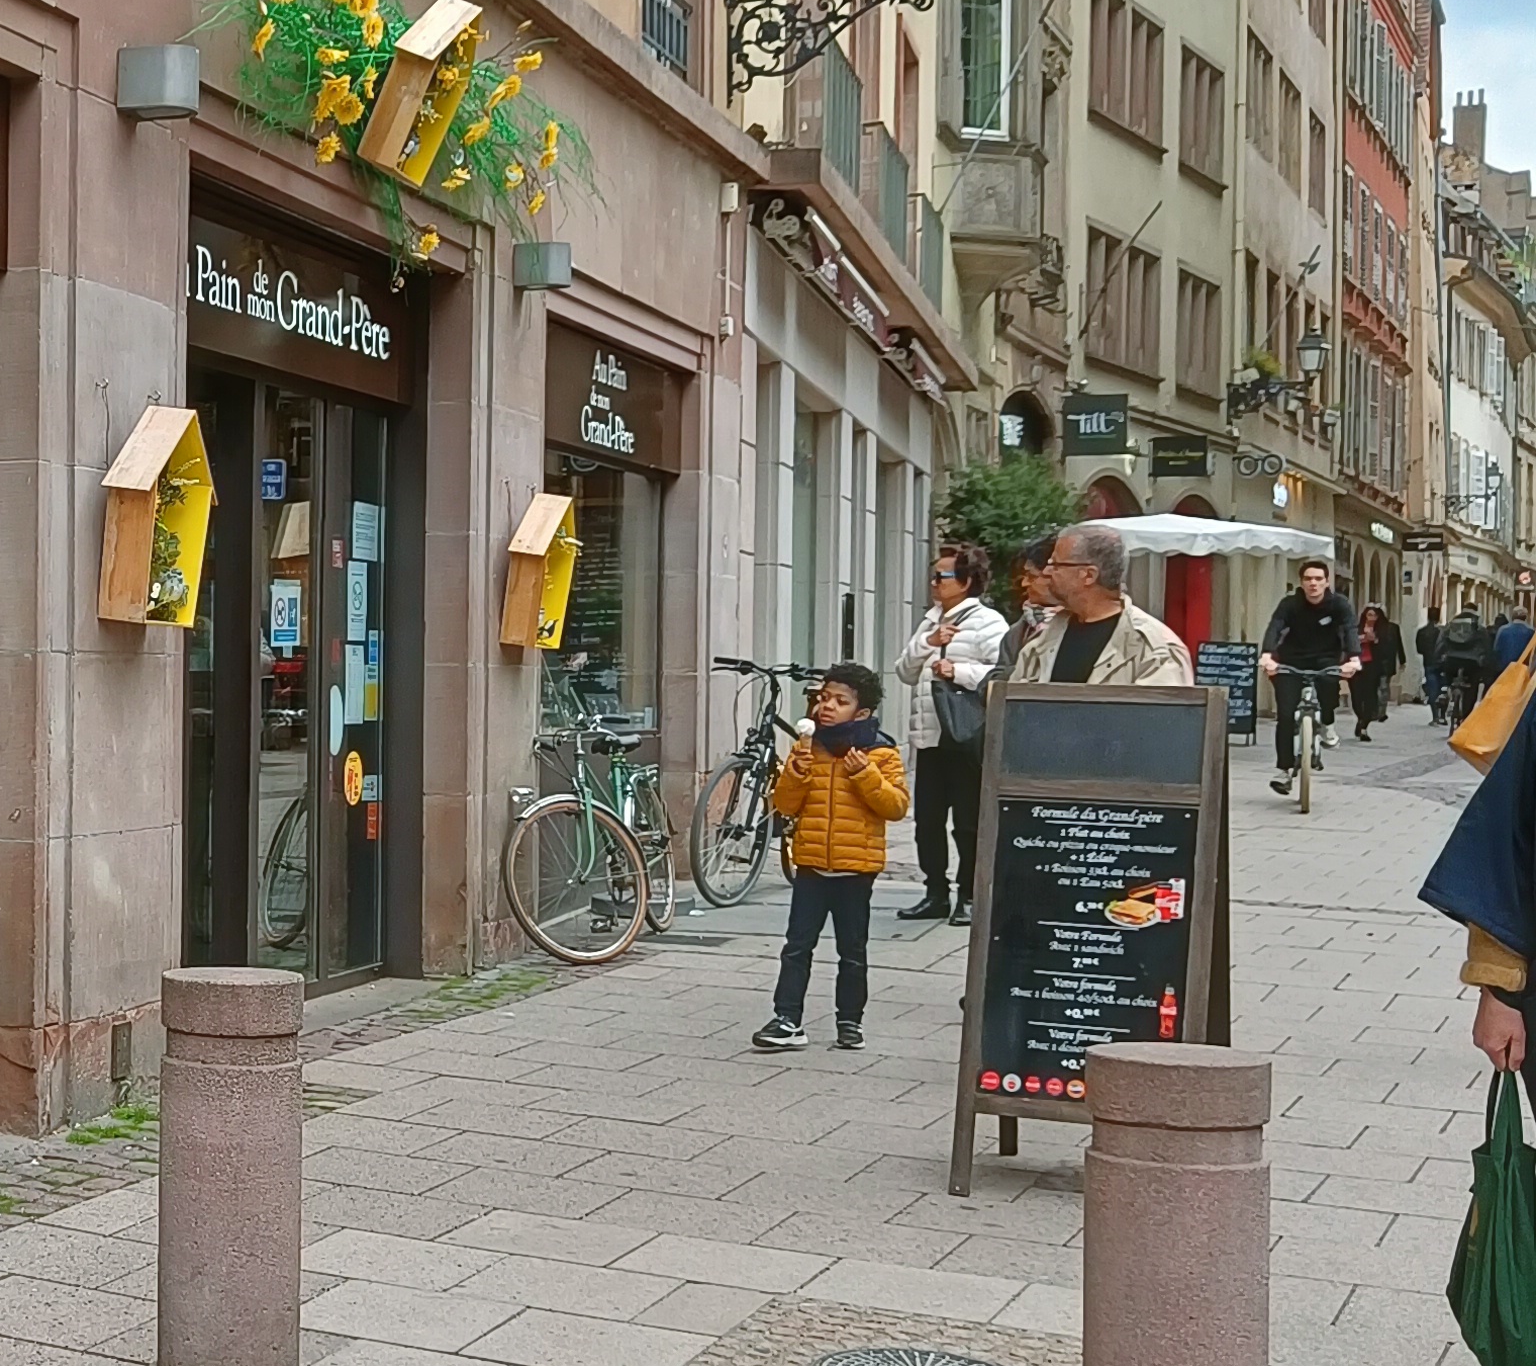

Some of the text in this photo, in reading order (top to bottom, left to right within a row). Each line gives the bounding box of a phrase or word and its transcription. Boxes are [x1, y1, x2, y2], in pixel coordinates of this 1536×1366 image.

[195, 244, 242, 314] Pain
[253, 259, 269, 295] de
[247, 292, 275, 322] mon
[276, 270, 391, 360] Grand-Père
[607, 354, 628, 391] Pain
[581, 405, 635, 454] Grand-Père
